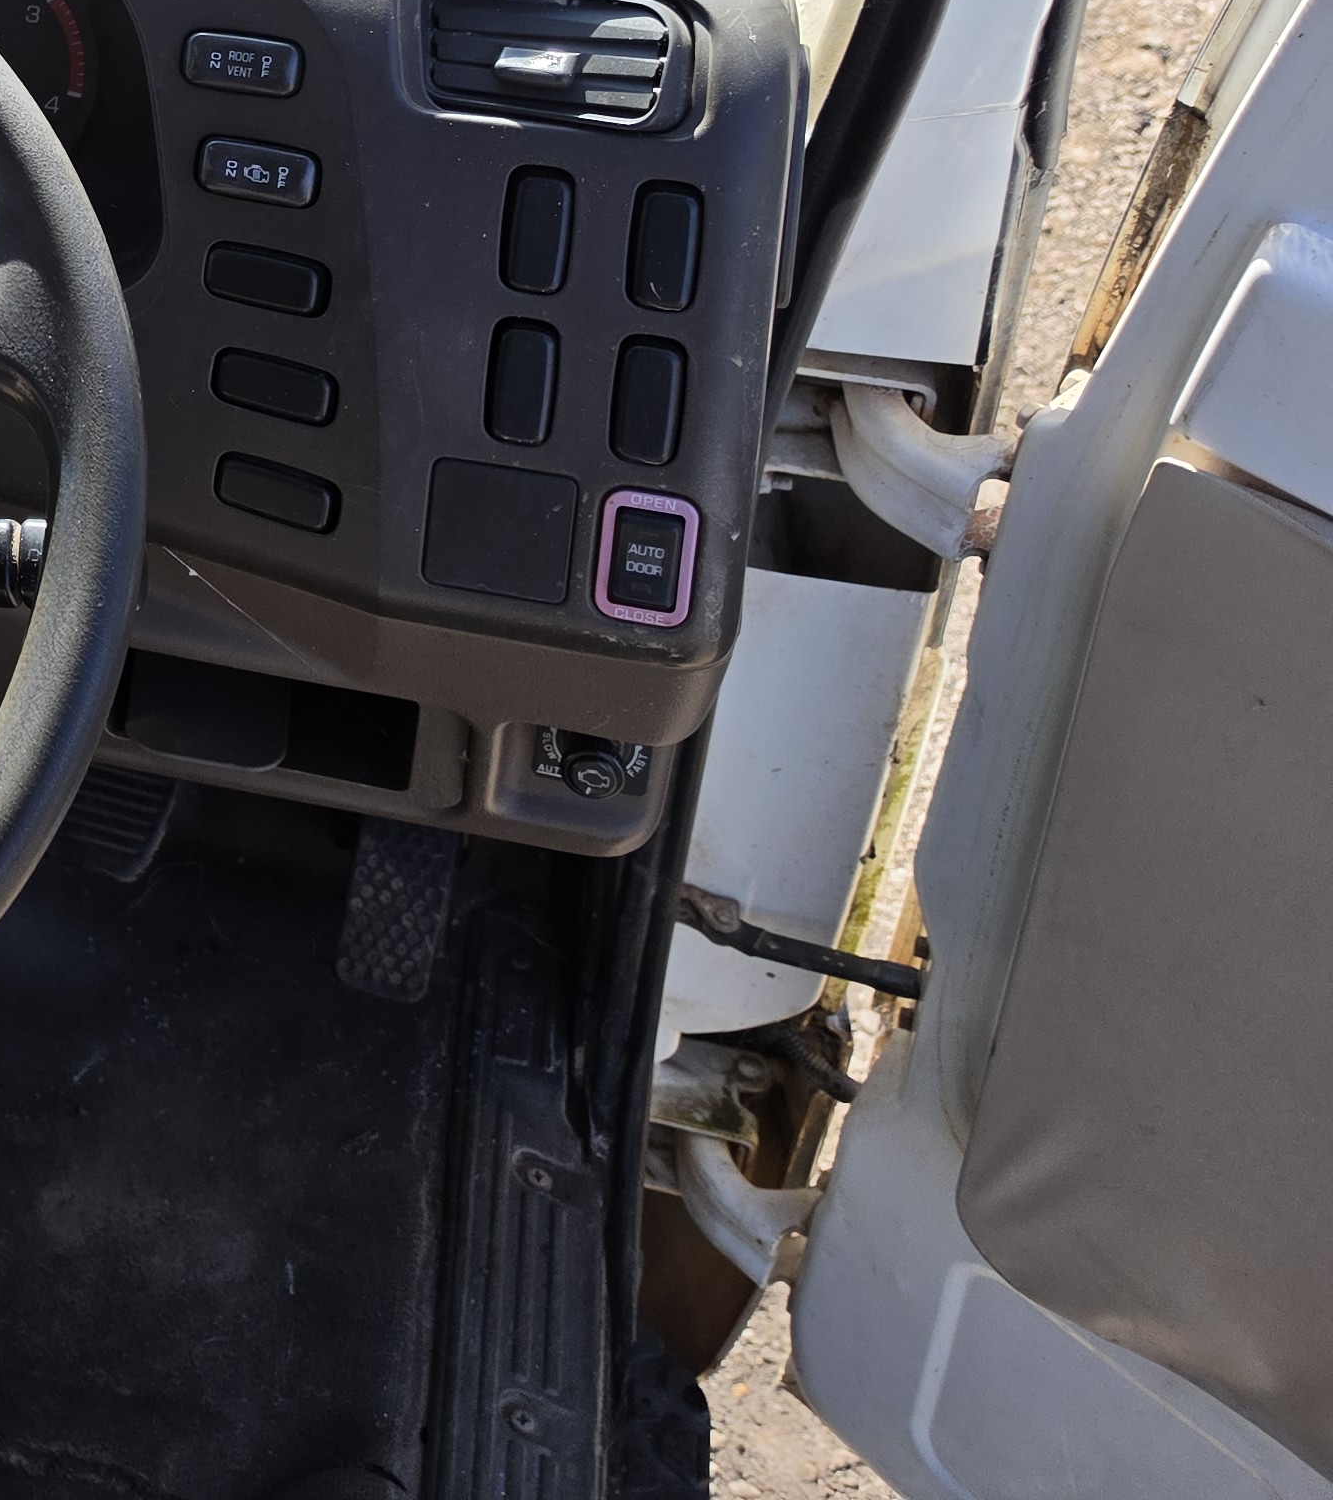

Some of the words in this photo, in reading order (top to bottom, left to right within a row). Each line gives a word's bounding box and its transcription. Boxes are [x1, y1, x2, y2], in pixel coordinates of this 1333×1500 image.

[25, 4, 42, 24] 3
[209, 52, 222, 69] ON
[228, 51, 255, 63] ROOF
[227, 65, 253, 78] VENT
[261, 55, 272, 78] OFF
[44, 95, 60, 114] 4
[225, 160, 237, 177] ON
[277, 166, 289, 188] OFF
[630, 494, 677, 511] OPEN
[628, 543, 665, 559] AUTO
[626, 561, 663, 577] DOOR
[614, 607, 665, 625] CLOSE
[543, 732, 557, 760] SLOW
[627, 753, 648, 778] FAST
